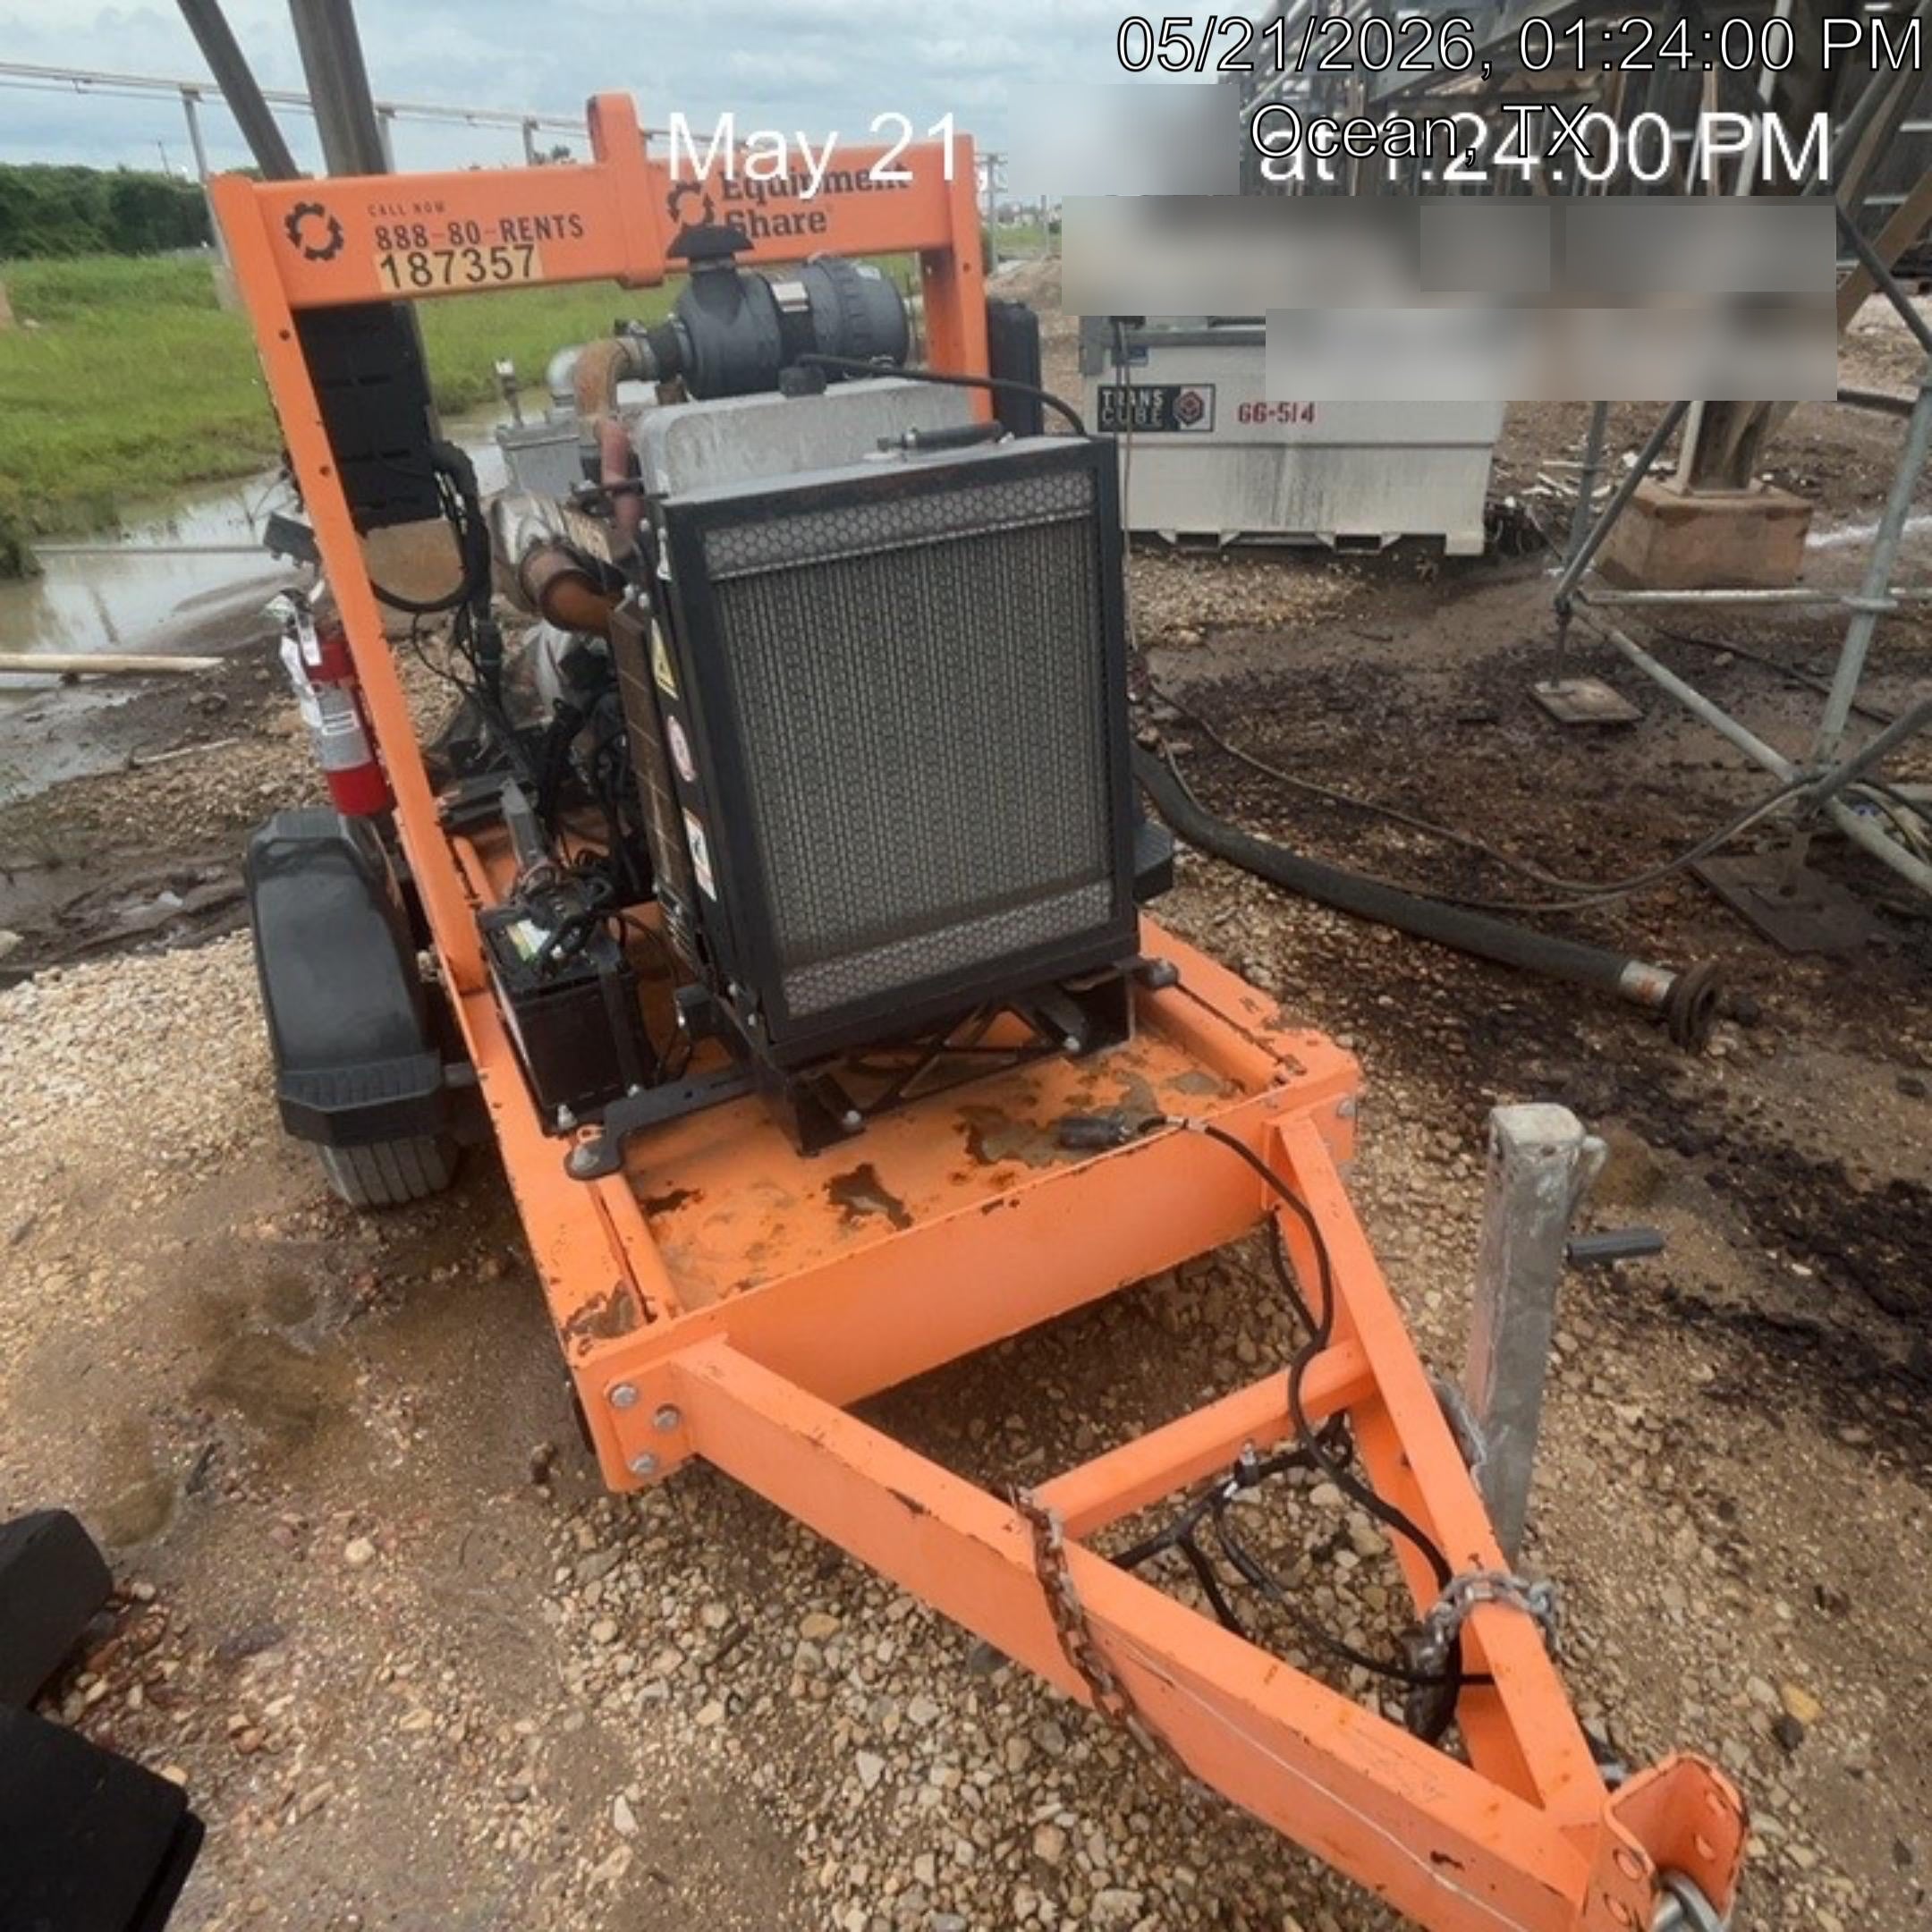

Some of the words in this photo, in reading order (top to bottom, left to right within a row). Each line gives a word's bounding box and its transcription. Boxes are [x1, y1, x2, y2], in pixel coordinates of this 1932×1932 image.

[368, 203, 406, 217] CALL
[413, 200, 445, 214] NOW
[375, 214, 584, 251] 888-80-RENTS
[380, 243, 535, 289] 187357
